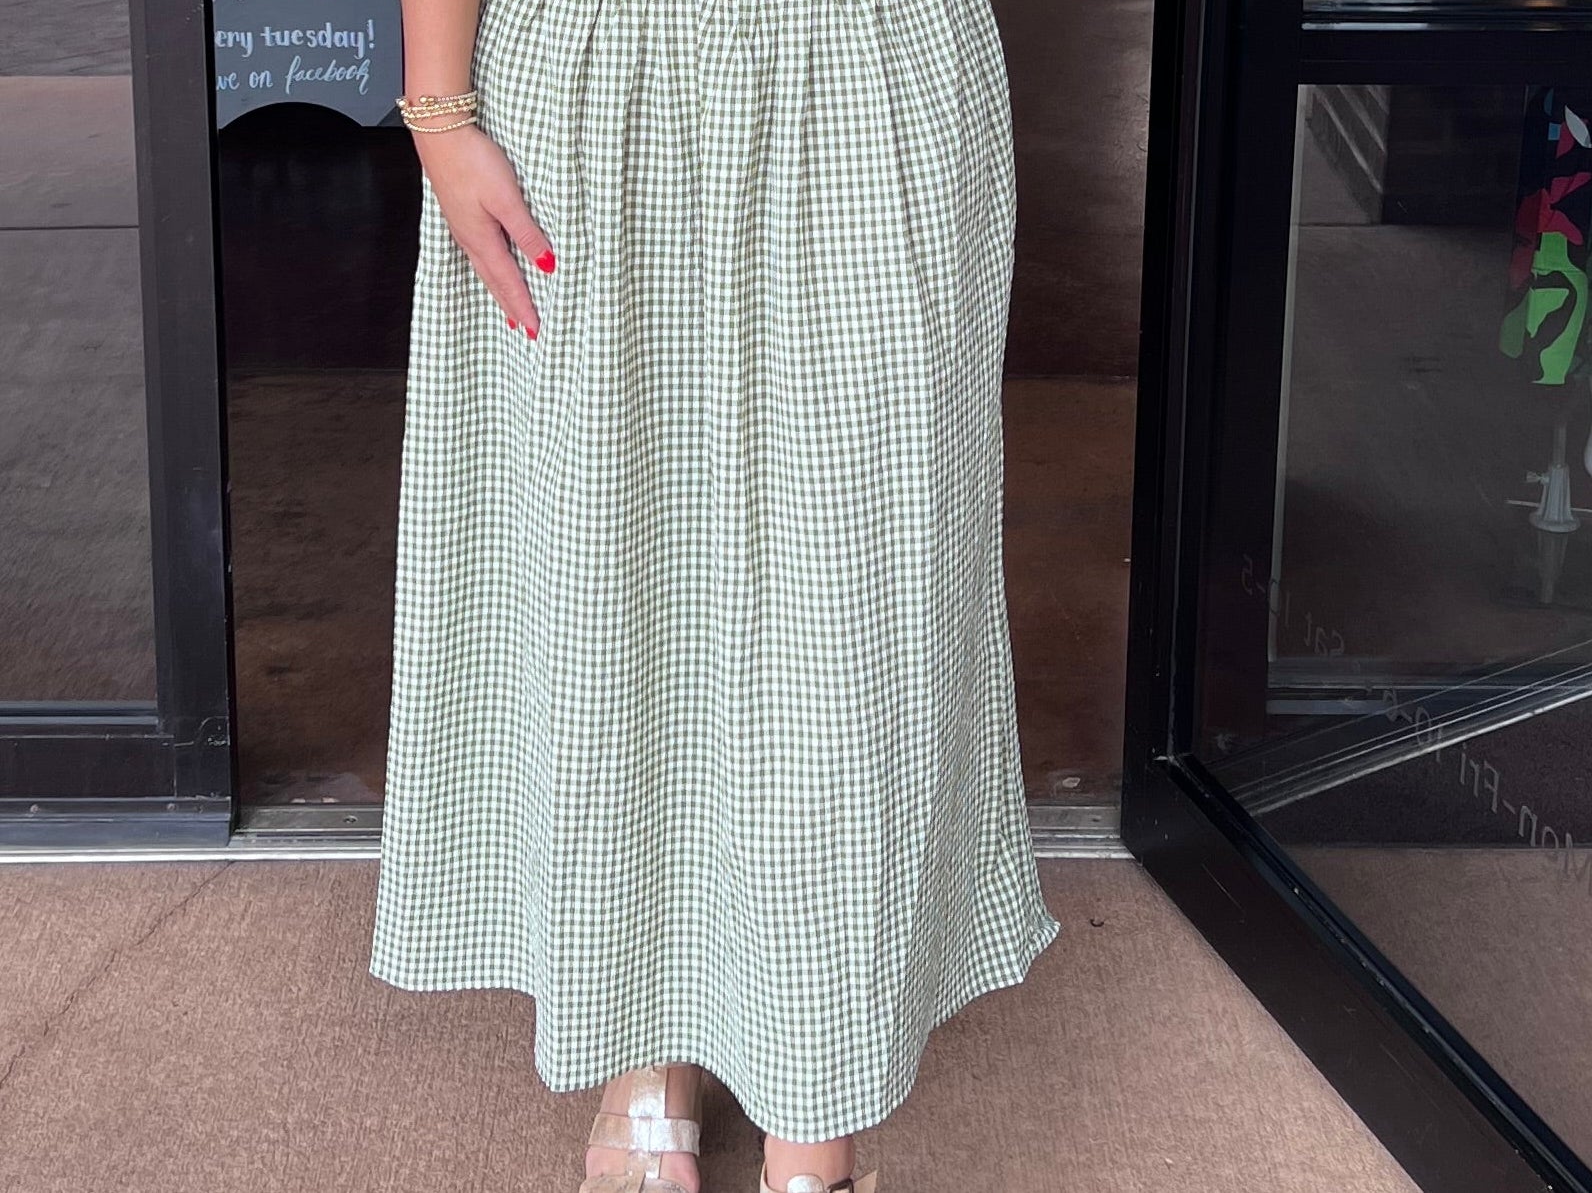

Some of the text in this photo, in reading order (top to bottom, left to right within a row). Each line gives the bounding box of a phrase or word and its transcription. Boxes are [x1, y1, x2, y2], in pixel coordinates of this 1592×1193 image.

[214, 19, 376, 60] ery tuesday!
[249, 71, 274, 89] on
[285, 55, 371, 96] facebook
